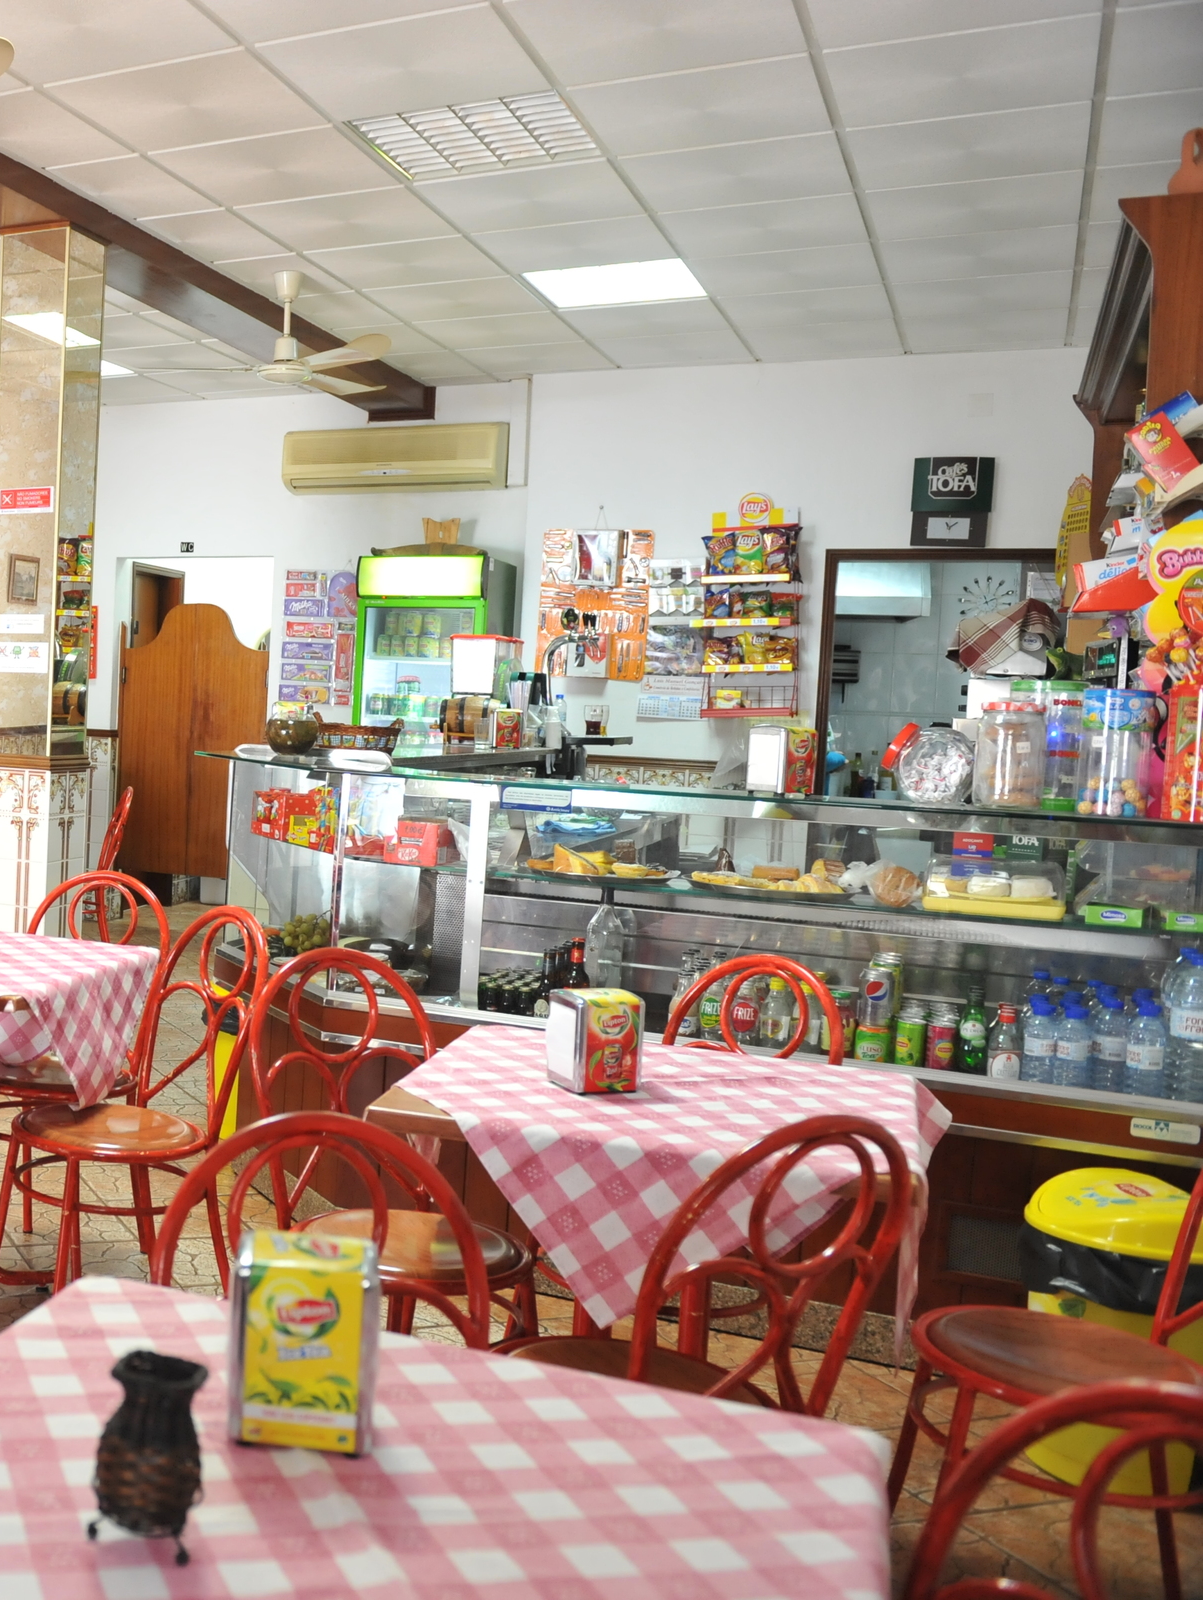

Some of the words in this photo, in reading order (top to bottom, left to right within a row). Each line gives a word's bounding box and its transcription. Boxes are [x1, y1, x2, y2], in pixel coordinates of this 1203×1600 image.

[938, 462, 968, 478] Cafés
[928, 474, 976, 492] TOFA
[181, 543, 194, 552] WC
[289, 600, 314, 613] Milka
[1102, 911, 1126, 919] Mimosa
[701, 1001, 720, 1014] FRIZE
[733, 1005, 755, 1021] FRIZE
[604, 1016, 626, 1027] Lipton
